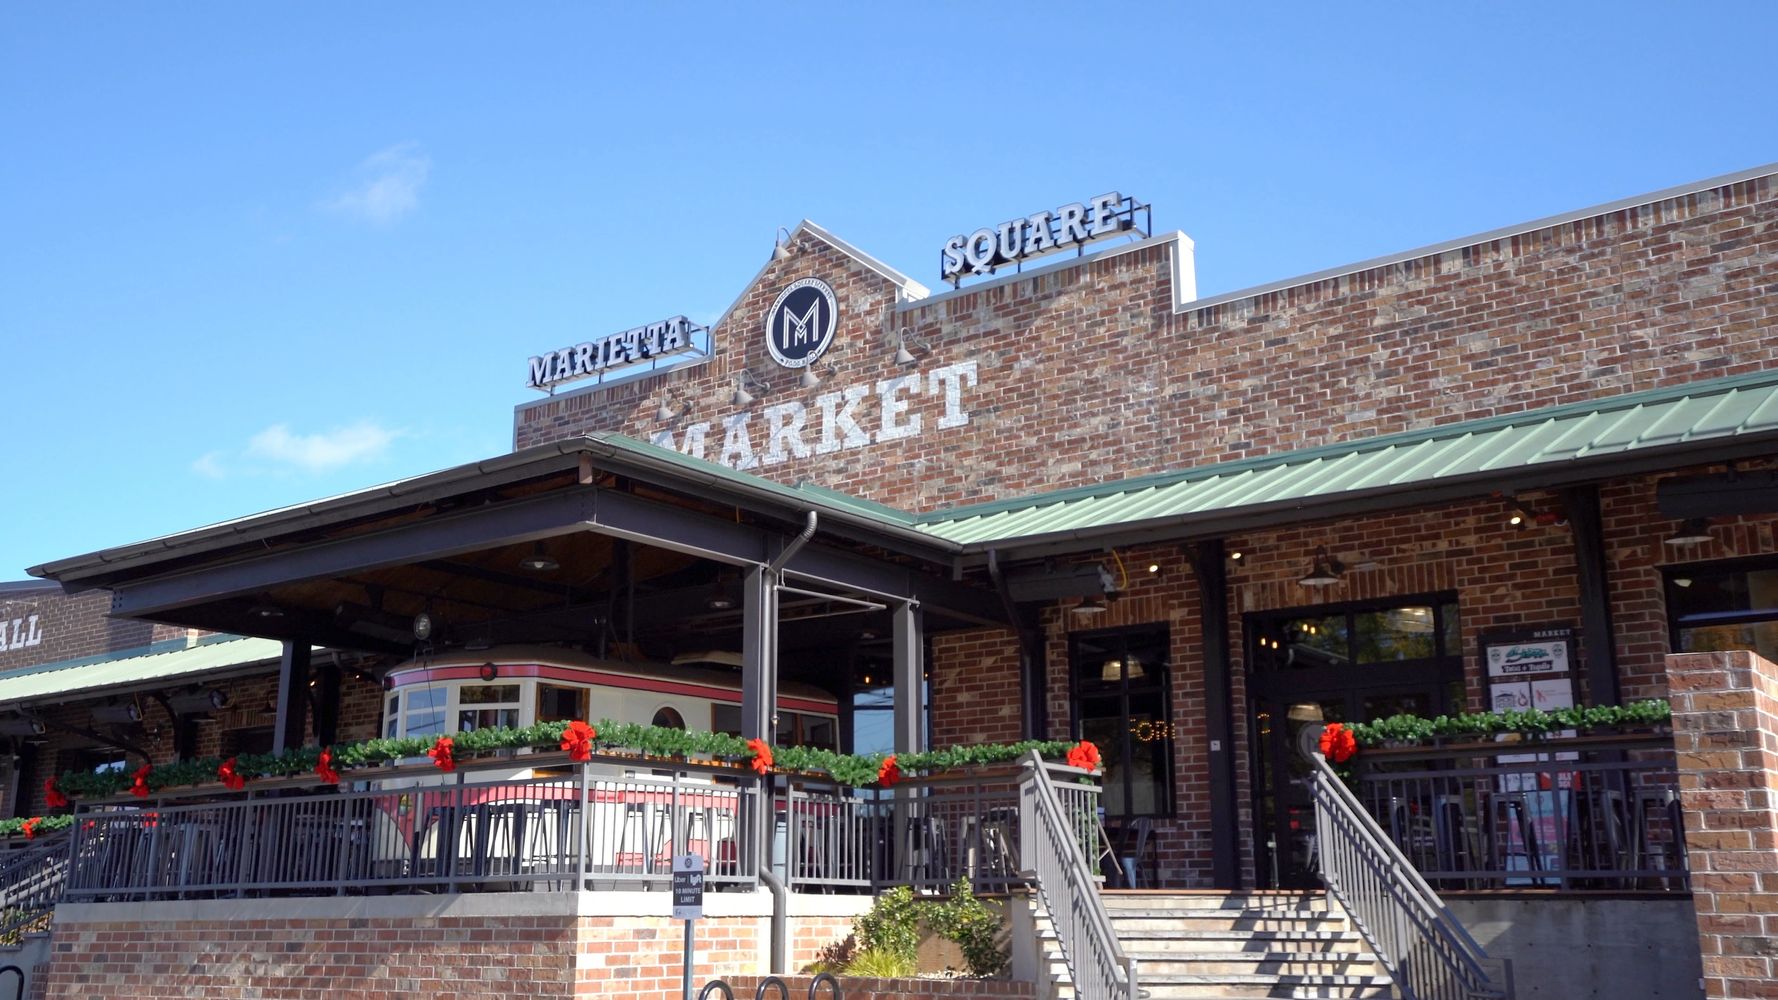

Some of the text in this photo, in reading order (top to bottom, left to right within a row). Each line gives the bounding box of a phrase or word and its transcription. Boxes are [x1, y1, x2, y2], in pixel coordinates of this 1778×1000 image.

[944, 191, 1122, 274] SQUARE
[527, 315, 690, 387] MARIETTA
[1534, 629, 1571, 638] MARKET
